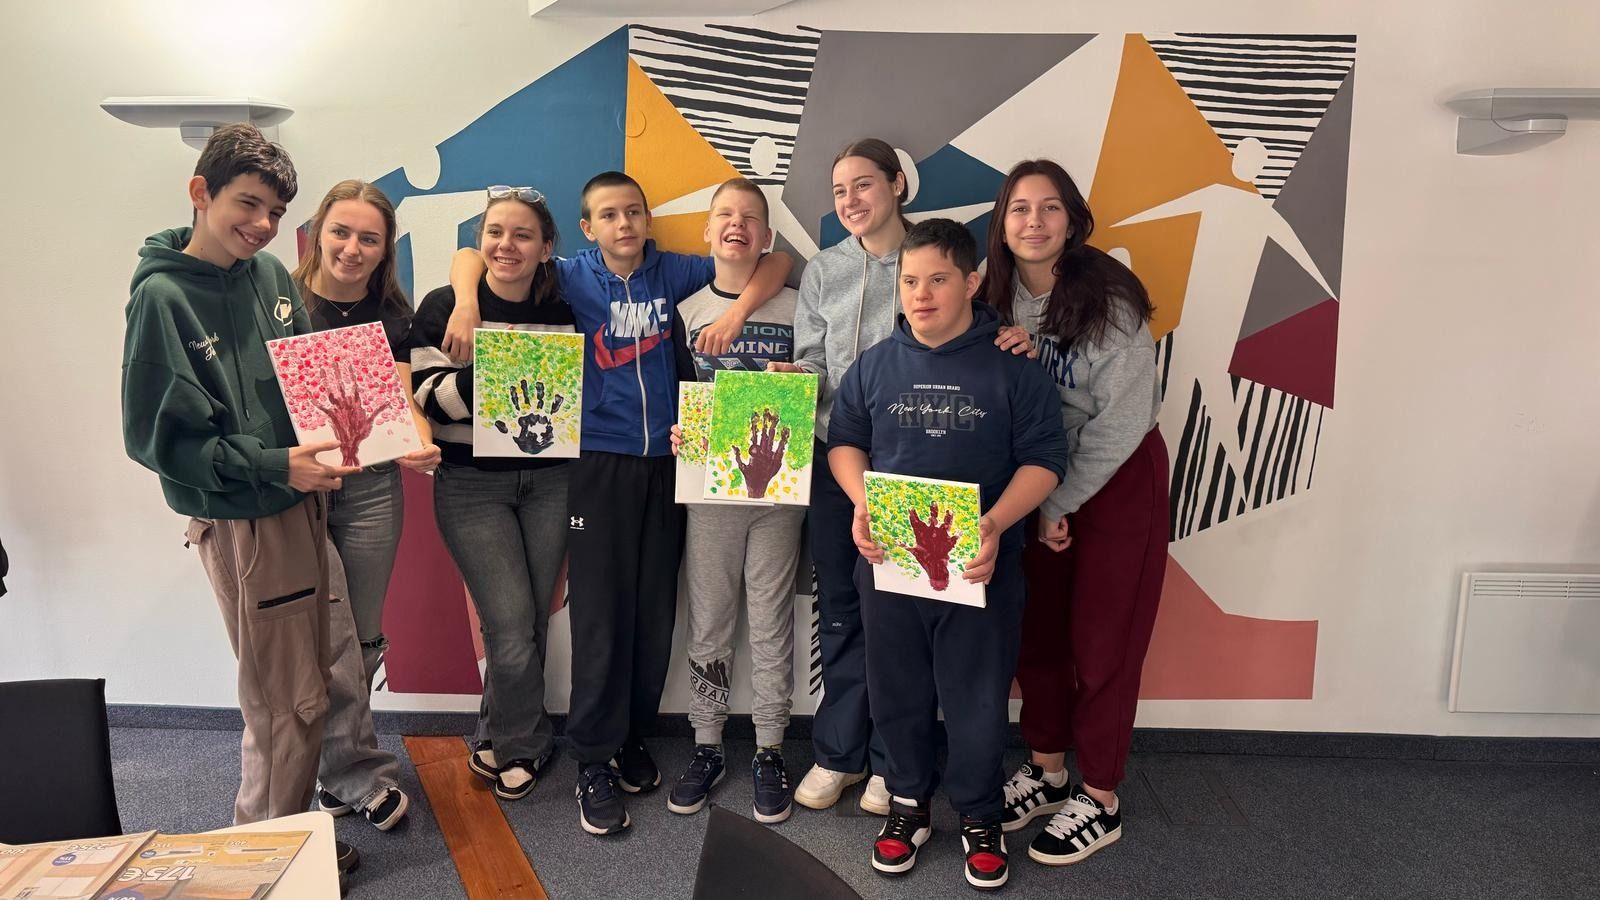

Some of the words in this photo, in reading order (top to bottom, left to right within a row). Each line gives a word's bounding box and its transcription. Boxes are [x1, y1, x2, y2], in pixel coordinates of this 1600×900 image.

[604, 298, 668, 338] NIKE
[741, 325, 793, 337] TION
[727, 341, 788, 354] MING
[1030, 335, 1079, 389] ORK
[887, 403, 917, 415] New
[919, 403, 953, 415] York
[957, 405, 988, 419] City
[117, 865, 196, 882] 175€
